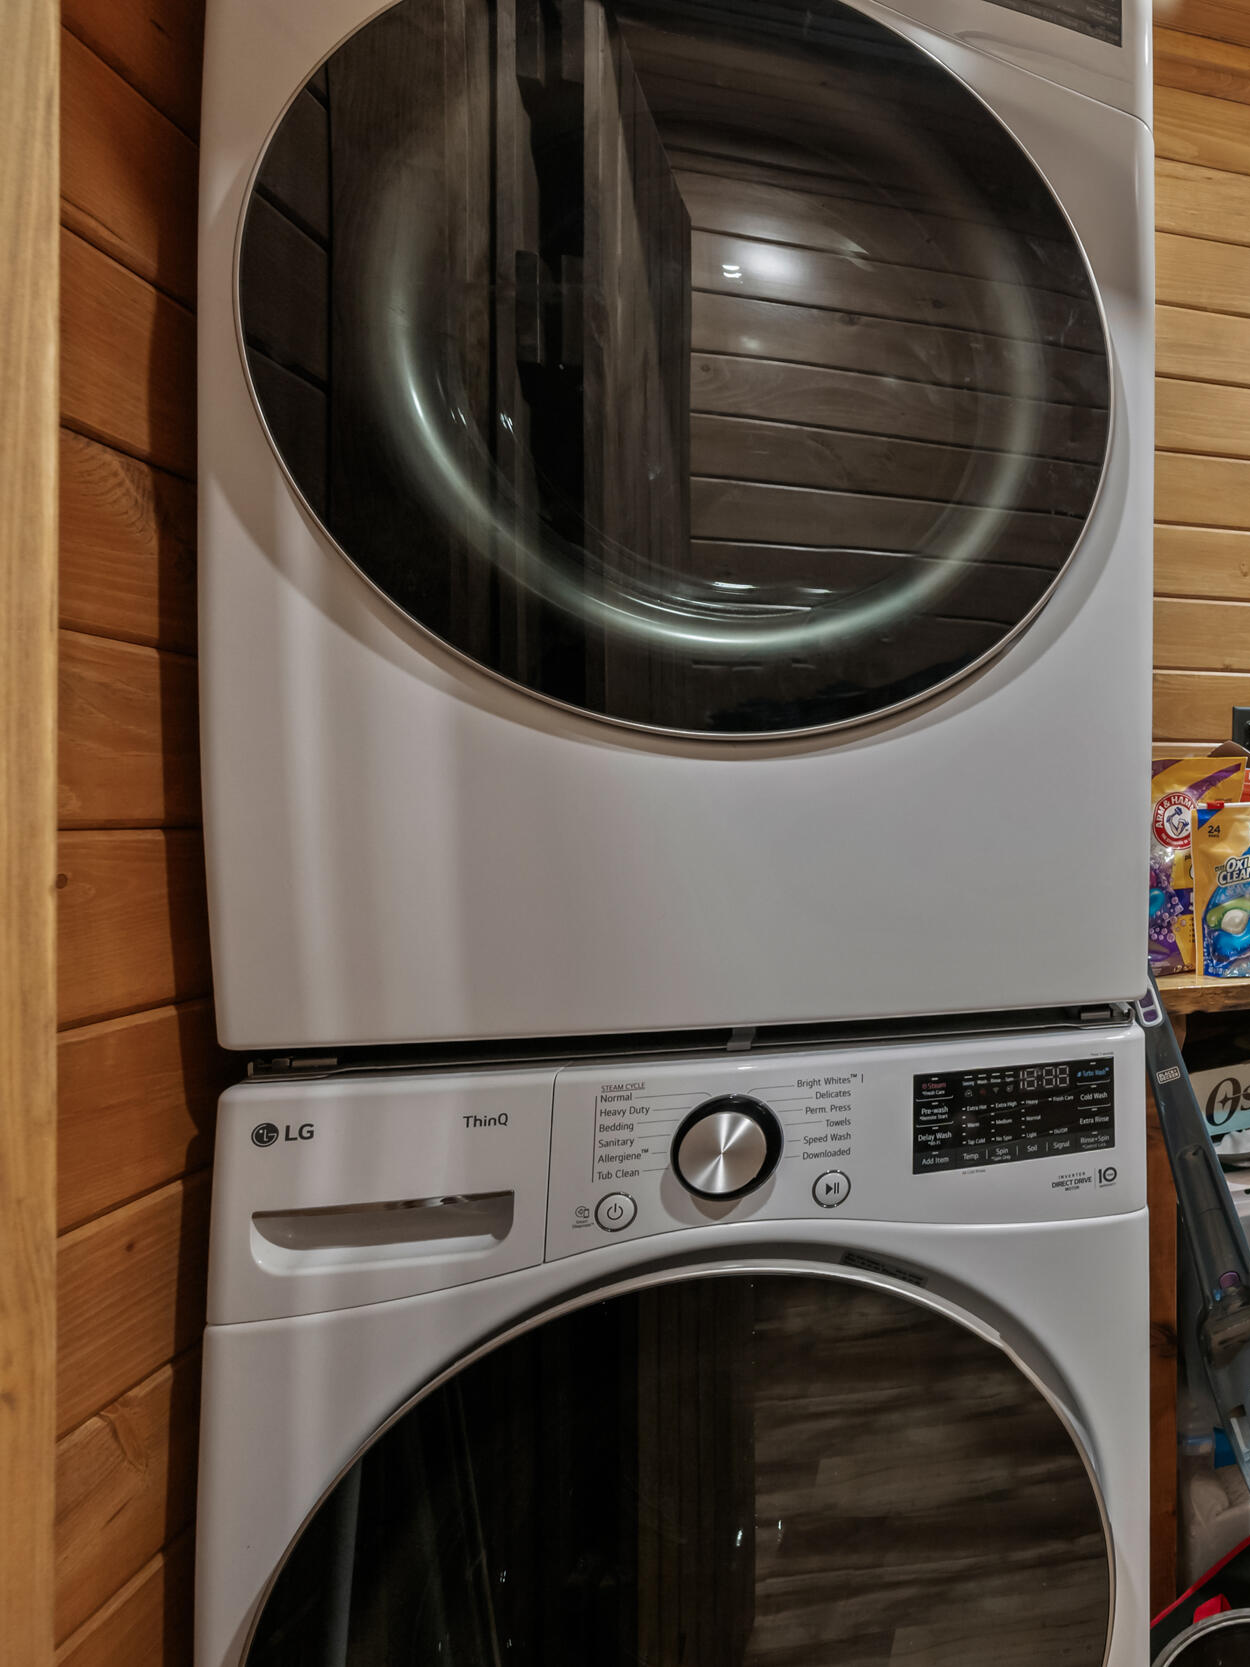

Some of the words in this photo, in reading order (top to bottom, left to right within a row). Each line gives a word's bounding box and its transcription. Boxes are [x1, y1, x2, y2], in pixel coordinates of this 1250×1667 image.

[1156, 806, 1166, 828] ARM
[1208, 825, 1220, 834] 24
[601, 1084, 624, 1092] STEAM
[797, 1078, 821, 1088] Bright
[600, 1092, 632, 1103] Normal
[816, 1090, 852, 1100] Delicates
[1080, 1093, 1092, 1101] Cold
[600, 1108, 626, 1118] Heavy
[629, 1106, 650, 1116] Duty
[806, 1106, 827, 1114] Perm.
[830, 1104, 852, 1112] Press
[922, 1106, 948, 1115] Pre-wash
[463, 1112, 508, 1128] ThinQ
[826, 1117, 852, 1128] Towels
[600, 1122, 634, 1132] Bedding
[284, 1124, 314, 1142] LG
[918, 1134, 934, 1143] Delay
[936, 1132, 952, 1140] Wash
[598, 1138, 634, 1148] Sanitary
[804, 1134, 828, 1146] Speed
[830, 1132, 852, 1142] Wash
[1053, 1141, 1070, 1150] Signal
[802, 1148, 850, 1160] Downloaded
[963, 1153, 978, 1161] Temp
[996, 1148, 1008, 1156] Spin
[922, 1157, 934, 1166] Add
[598, 1172, 612, 1180] Tub
[615, 1168, 640, 1178] Clean
[1052, 1178, 1072, 1188] DIRECT
[1074, 1176, 1092, 1185] DRIVE
